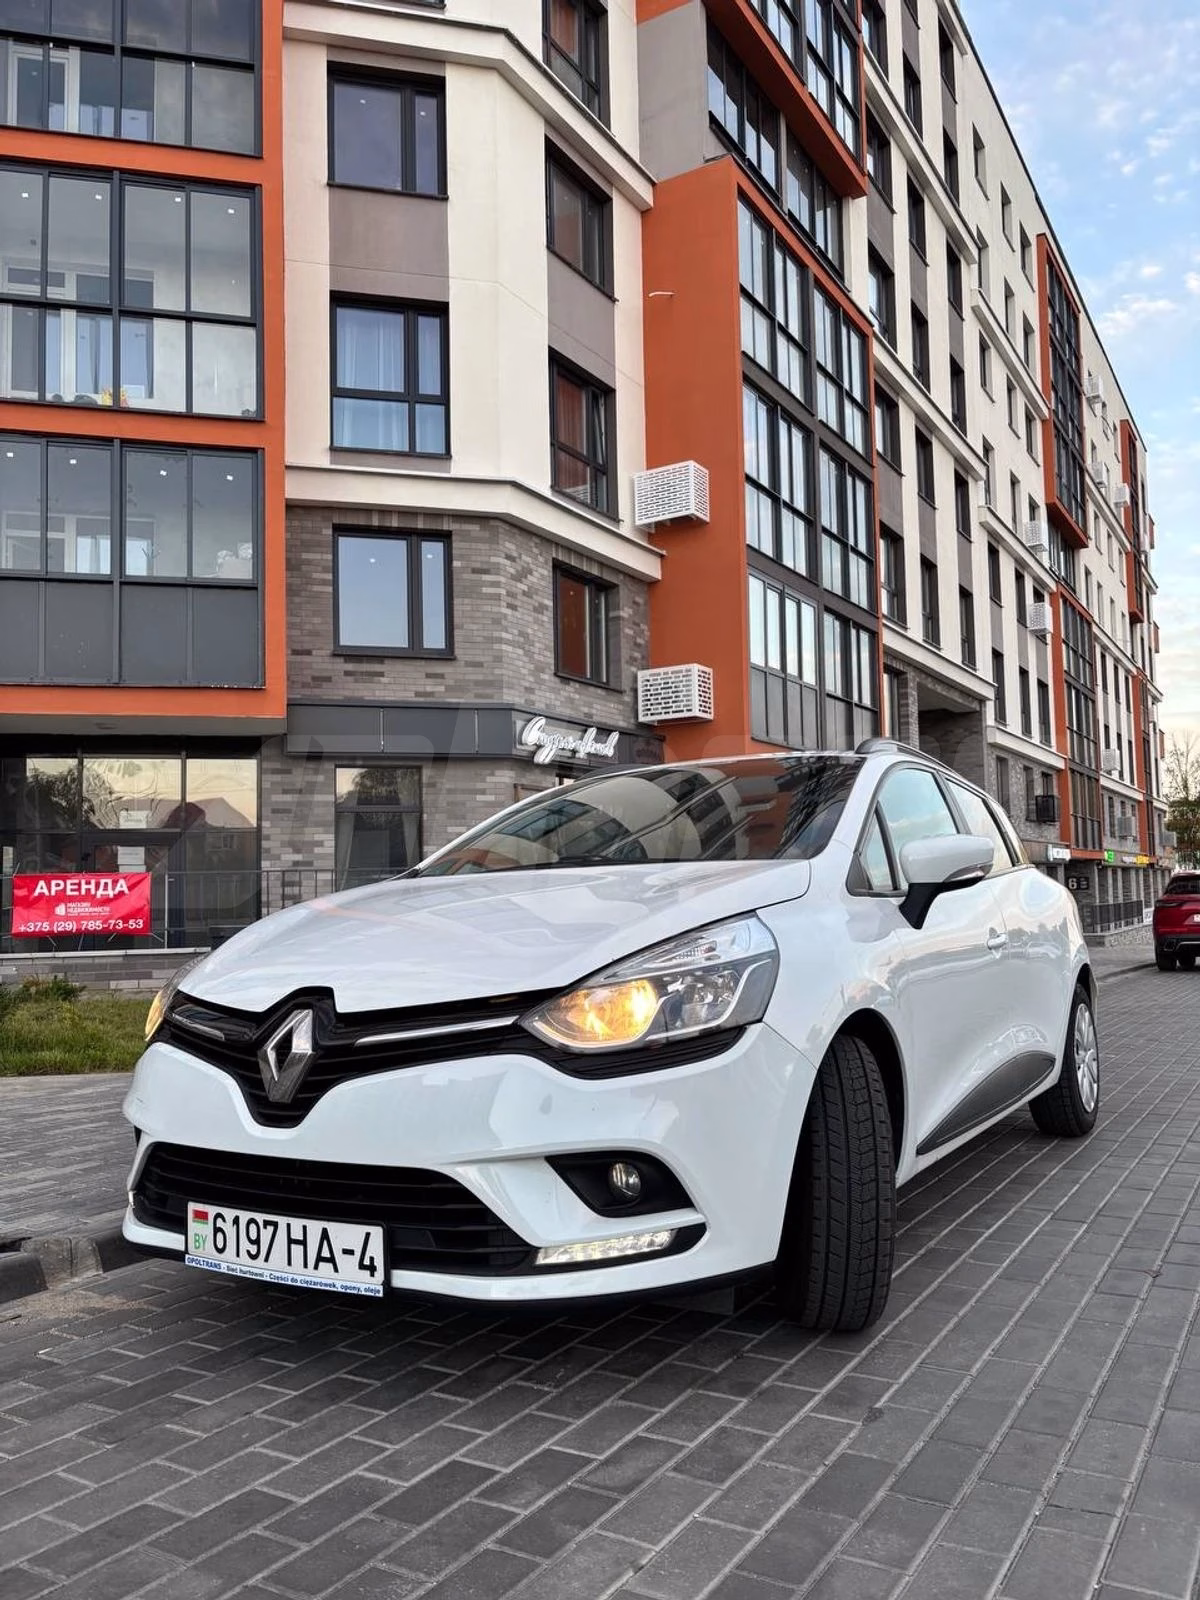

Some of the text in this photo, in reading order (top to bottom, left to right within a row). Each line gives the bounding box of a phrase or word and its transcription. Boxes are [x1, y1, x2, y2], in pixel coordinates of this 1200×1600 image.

[33, 878, 129, 898] АРЕНДА
[18, 918, 144, 932] +375 (29) 785-73-53
[193, 1231, 208, 1251] BY
[186, 1256, 222, 1270] OPOLTRANS
[290, 1276, 299, 1284] do
